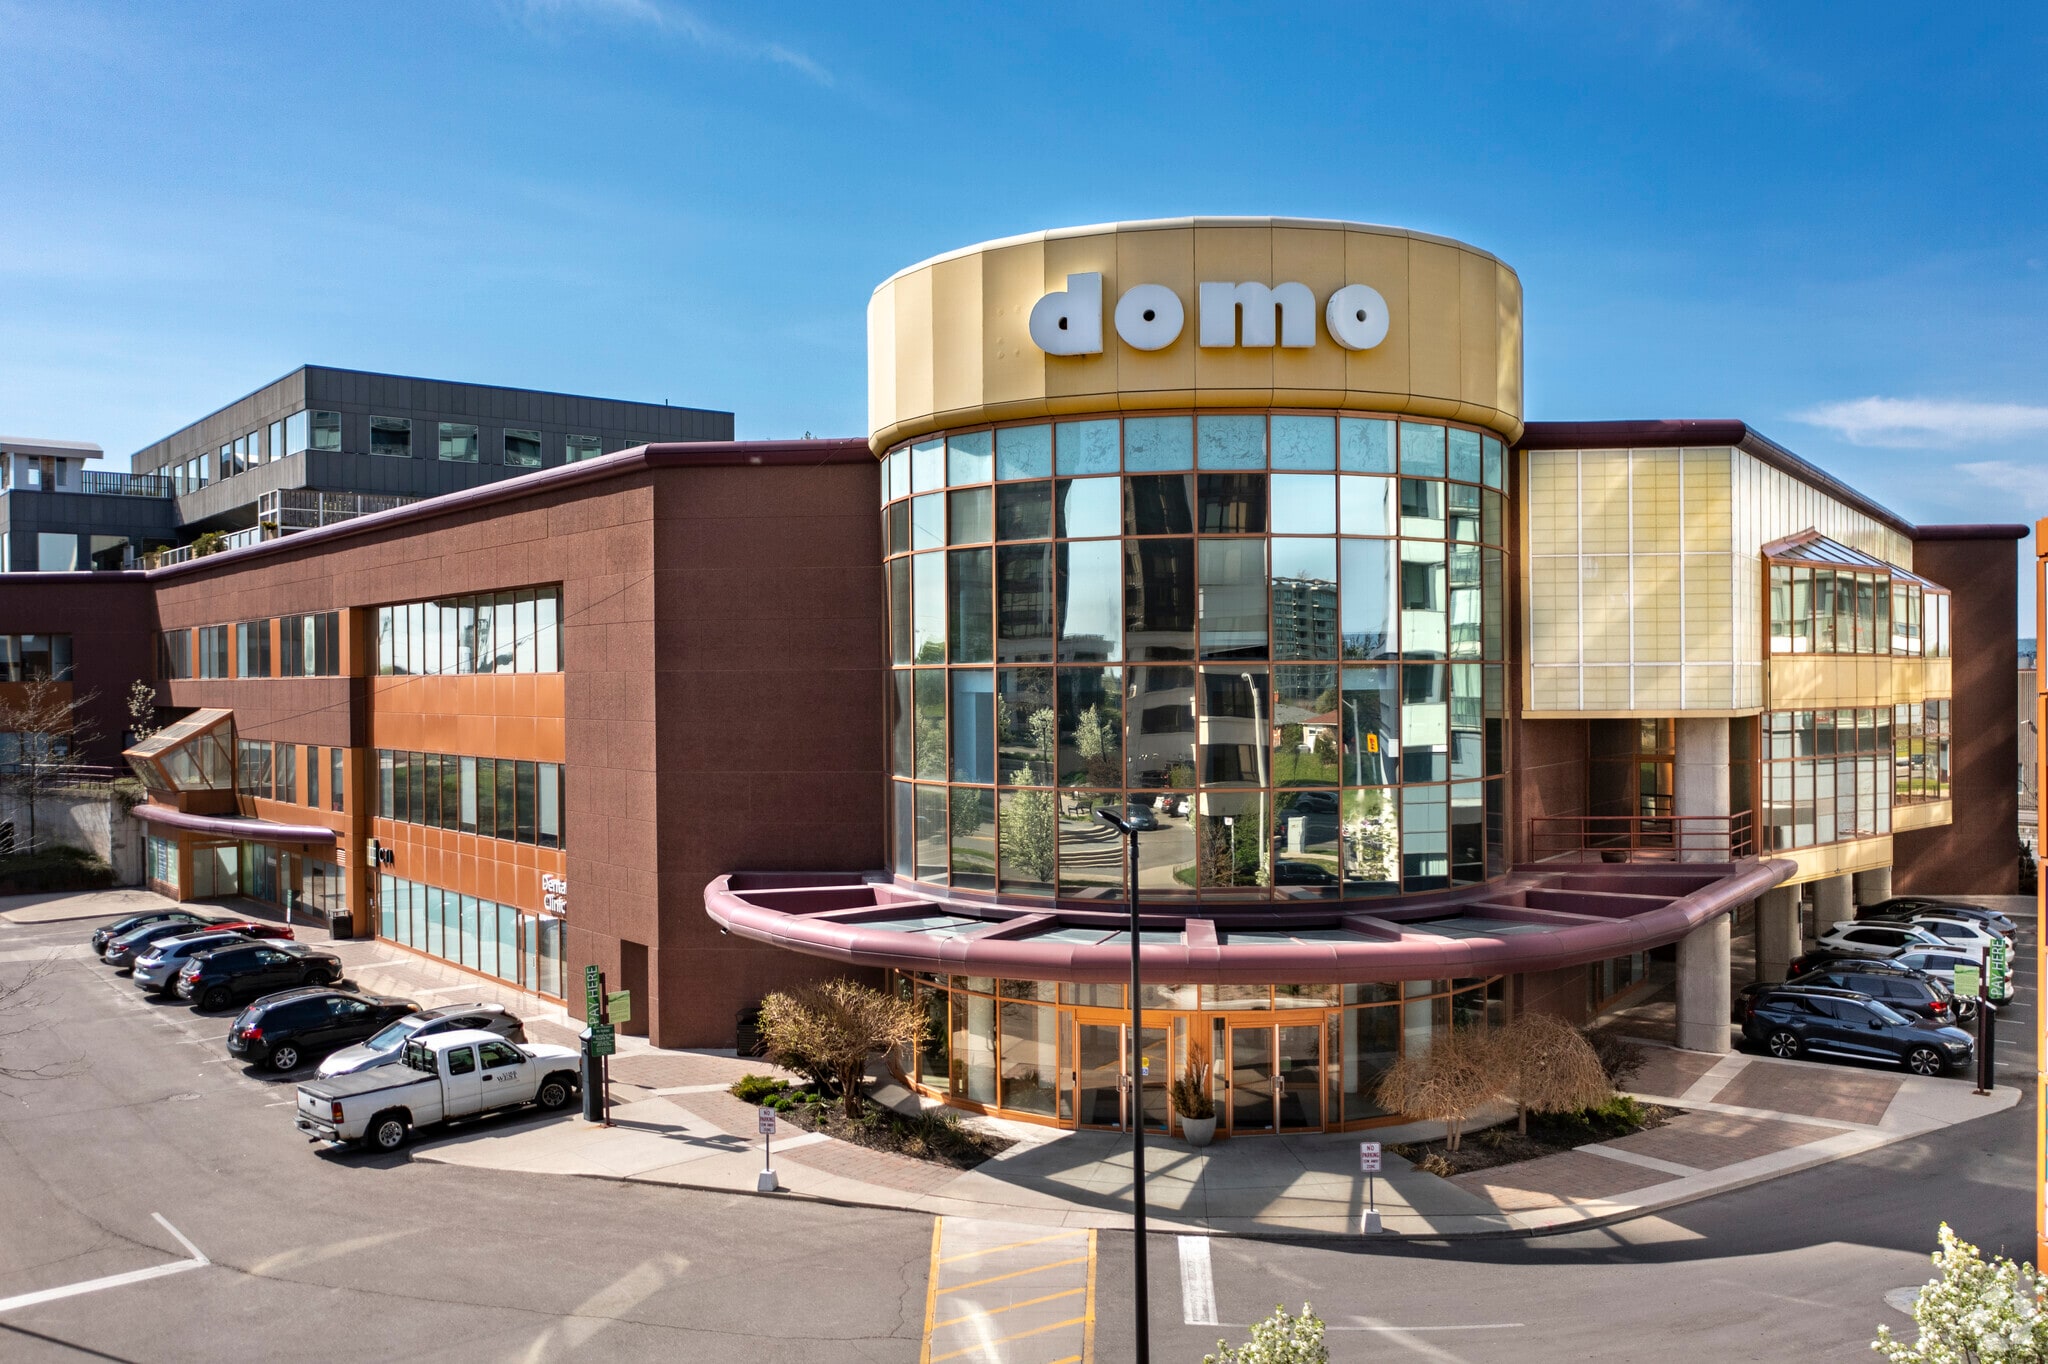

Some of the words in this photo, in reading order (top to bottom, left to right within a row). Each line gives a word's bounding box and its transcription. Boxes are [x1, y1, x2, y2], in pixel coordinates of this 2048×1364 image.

[1029, 271, 1390, 356] domo
[541, 873, 567, 895] Denta
[1991, 939, 2003, 971] HERE
[586, 967, 598, 998] HERE
[1991, 974, 2003, 996] PAY
[588, 1002, 600, 1025] PAY
